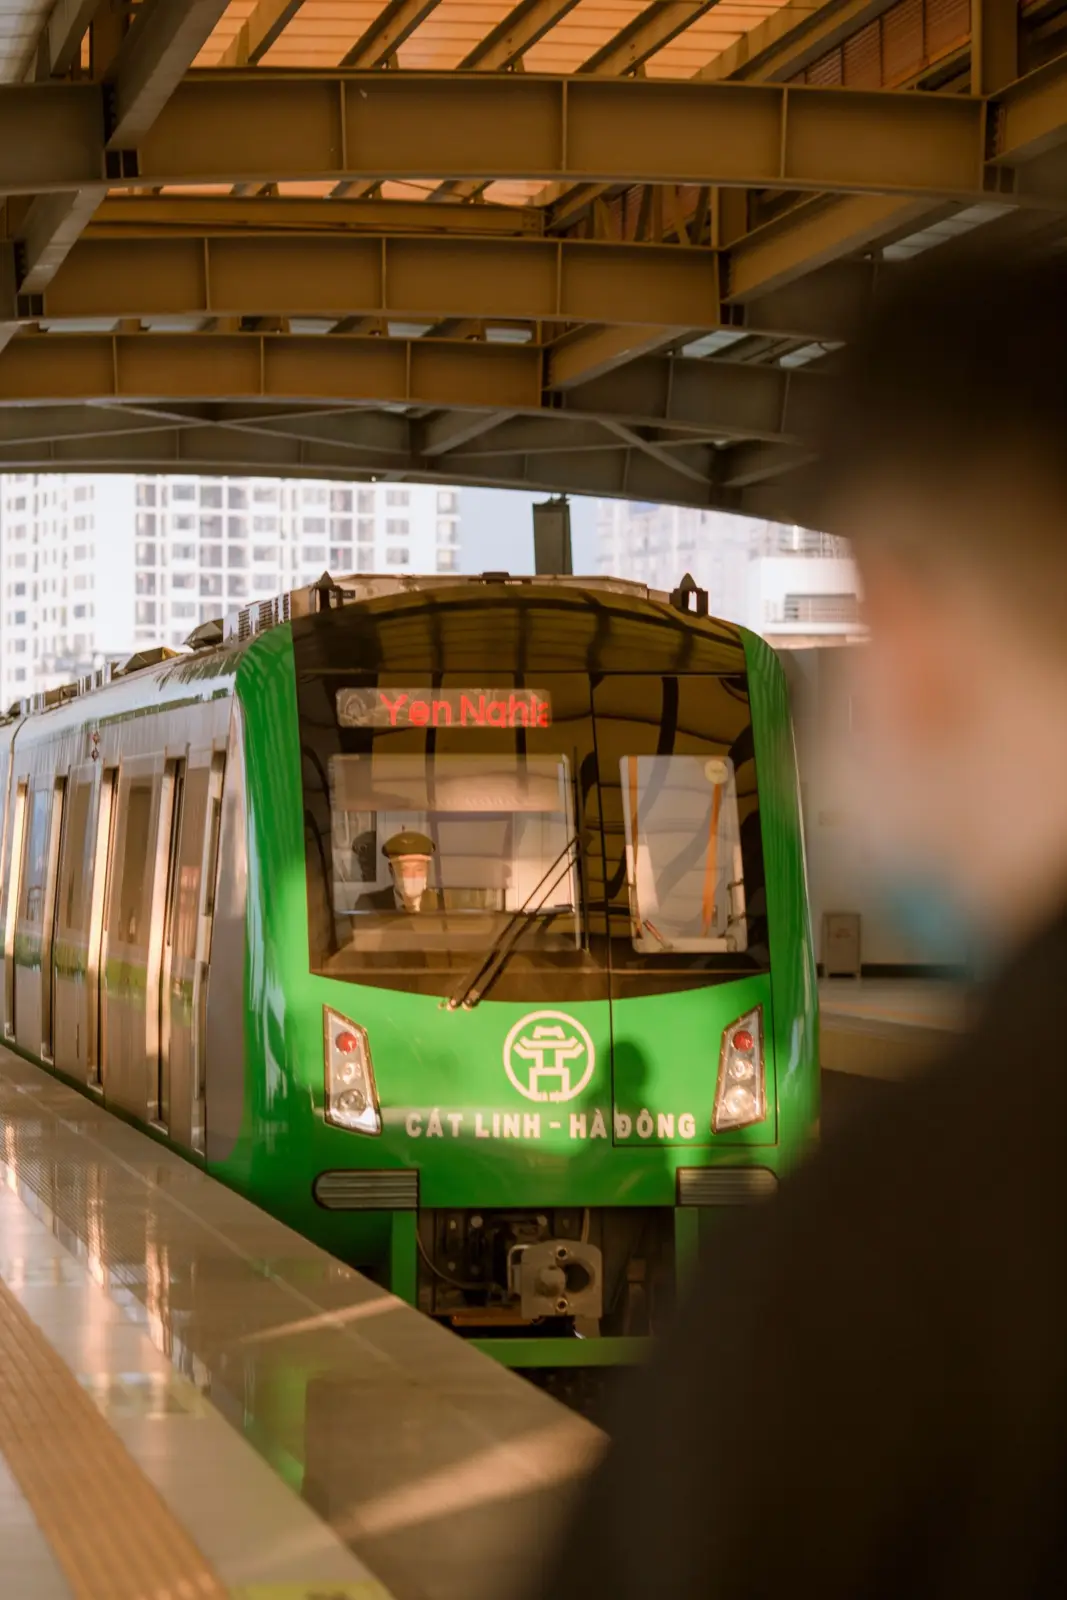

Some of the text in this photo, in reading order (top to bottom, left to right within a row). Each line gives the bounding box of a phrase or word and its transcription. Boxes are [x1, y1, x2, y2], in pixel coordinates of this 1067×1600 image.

[380, 693, 452, 726] Yen
[405, 1107, 463, 1138] CÁT
[475, 1113, 541, 1138] LINH
[569, 1107, 607, 1139] HÀ
[614, 1107, 696, 1139] ĐÔNG
